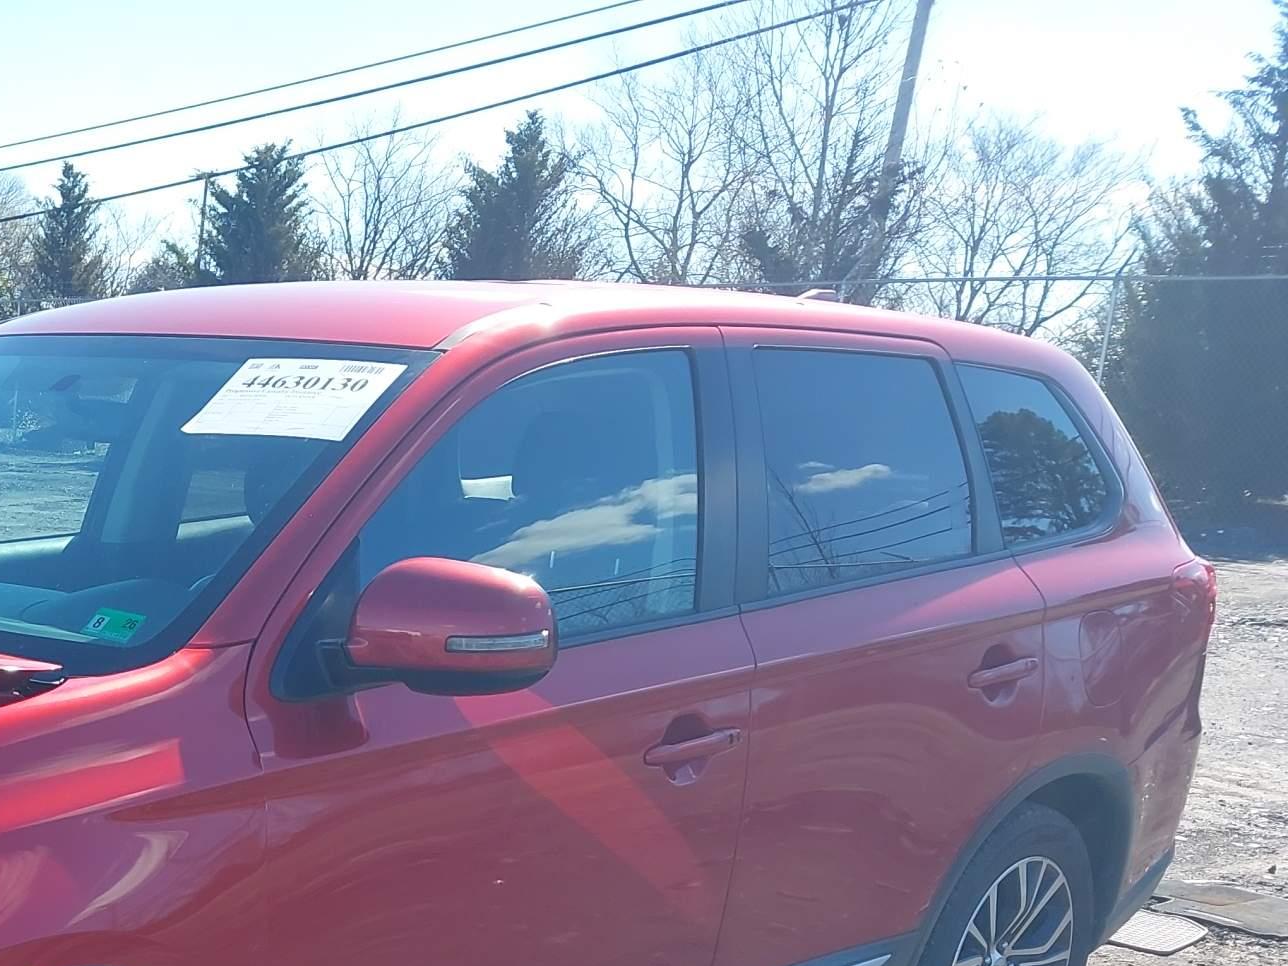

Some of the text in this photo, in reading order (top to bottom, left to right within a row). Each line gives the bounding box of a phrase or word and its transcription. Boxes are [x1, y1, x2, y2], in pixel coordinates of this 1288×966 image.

[241, 375, 369, 393] 44630130
[93, 616, 139, 630] 8 26
